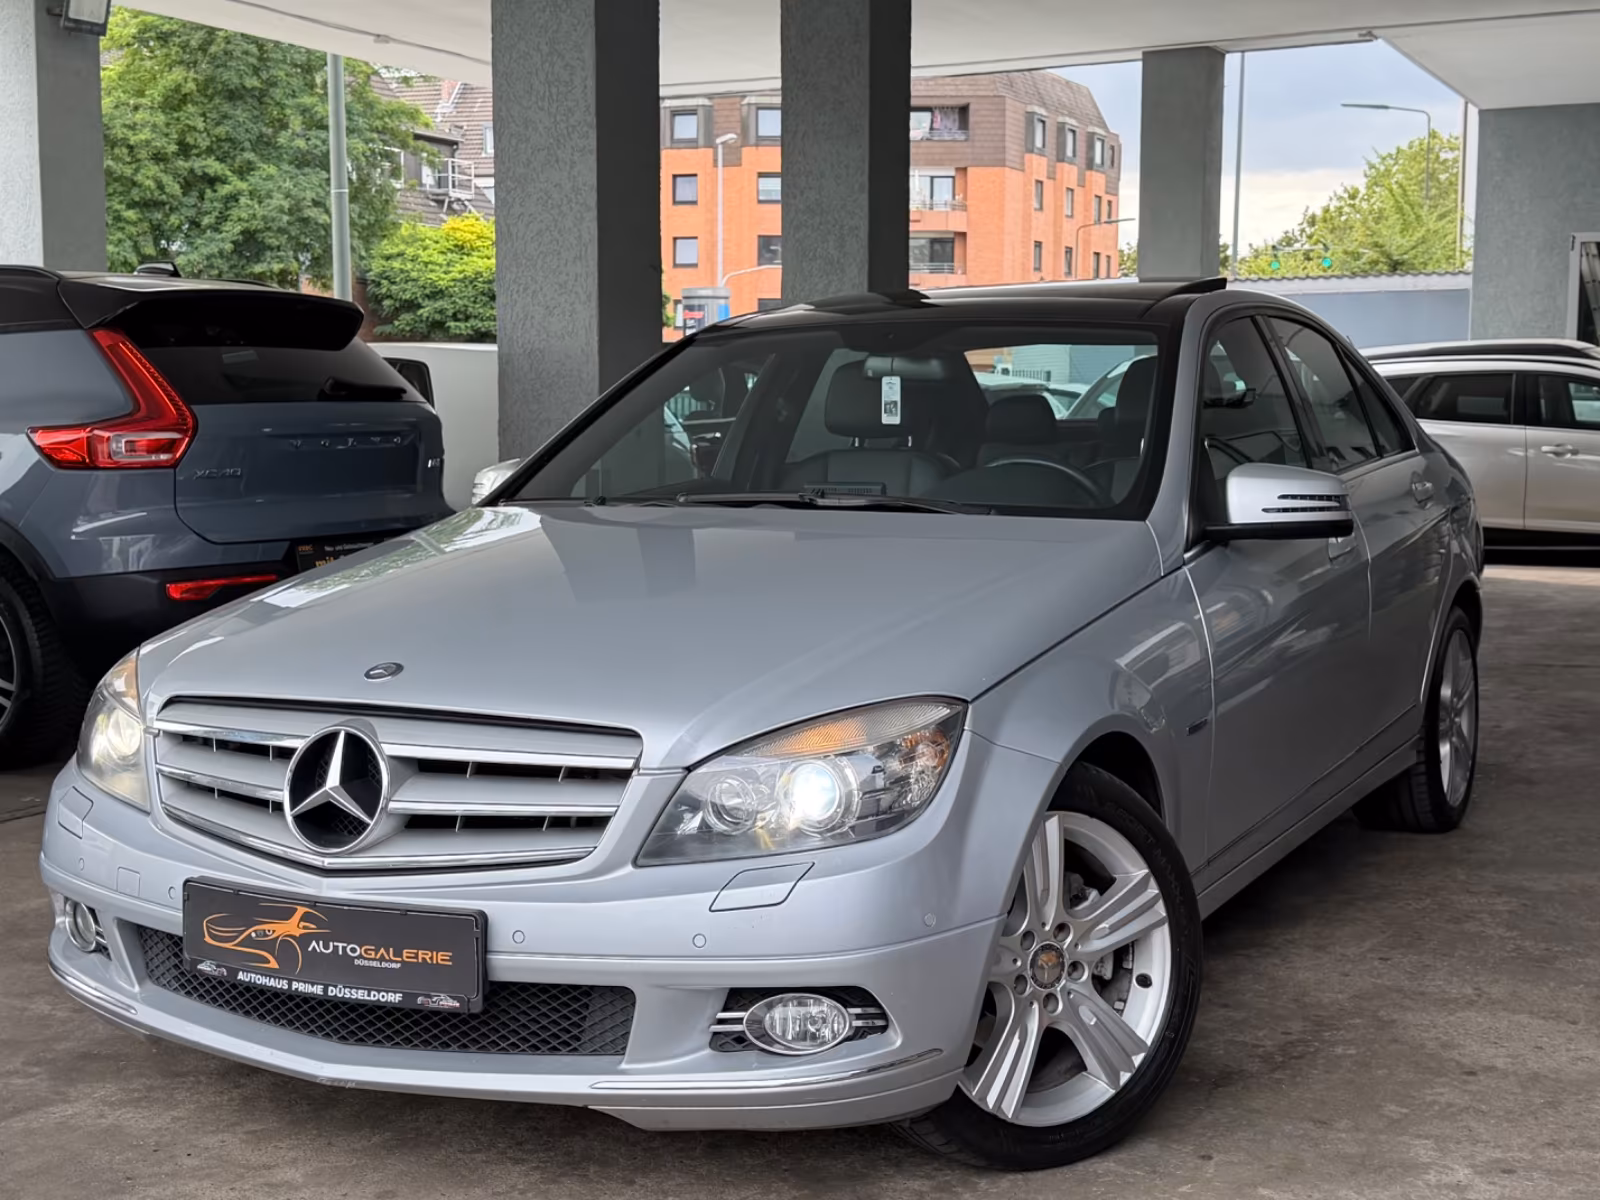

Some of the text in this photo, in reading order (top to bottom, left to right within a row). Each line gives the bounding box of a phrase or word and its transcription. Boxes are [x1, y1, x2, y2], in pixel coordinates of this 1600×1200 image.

[307, 940, 453, 965] AUTOGALERIE
[354, 958, 402, 969] DÜSSELDORF
[236, 970, 403, 1003] AUTOHAUS PRIME DÜSSELDORF
